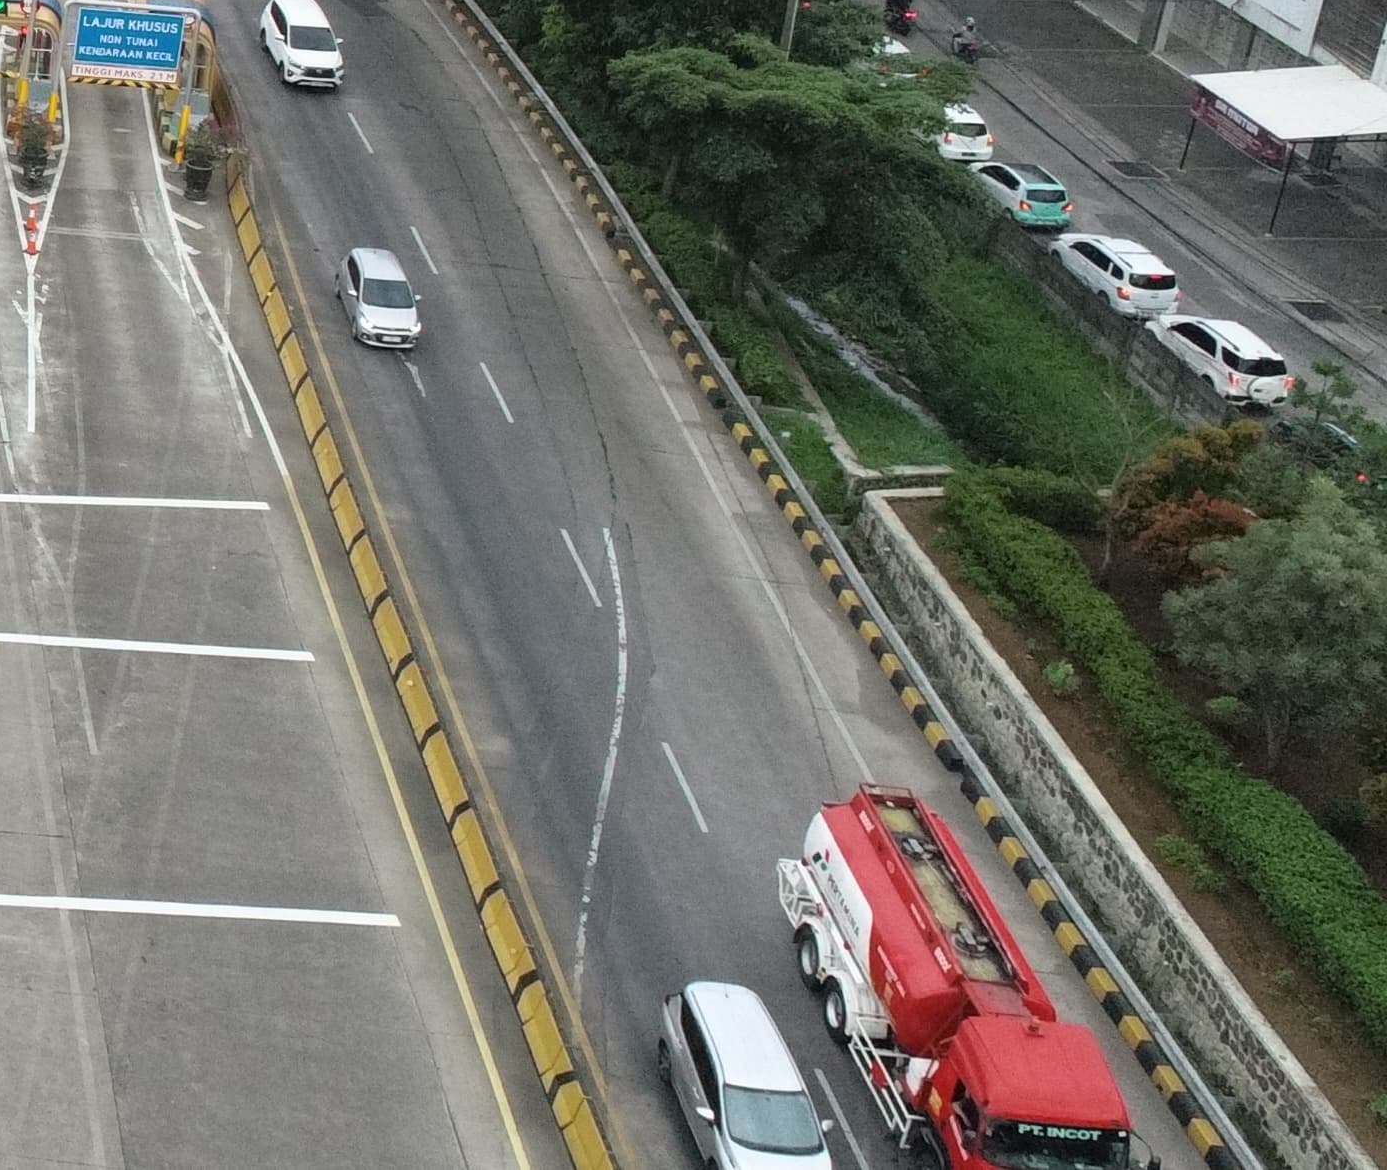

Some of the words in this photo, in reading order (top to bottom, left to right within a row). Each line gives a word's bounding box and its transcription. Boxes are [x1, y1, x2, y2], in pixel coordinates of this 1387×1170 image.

[83, 15, 124, 30] LAJUR
[128, 19, 178, 34] KHUSUS
[99, 34, 122, 45] NON
[126, 36, 158, 47] TUNAI
[79, 45, 143, 59] KENDARAAN
[146, 51, 175, 62] KECIL
[74, 66, 112, 76] TINGGI
[1018, 1123, 1045, 1137] PT.
[1046, 1126, 1102, 1141] INCOT
